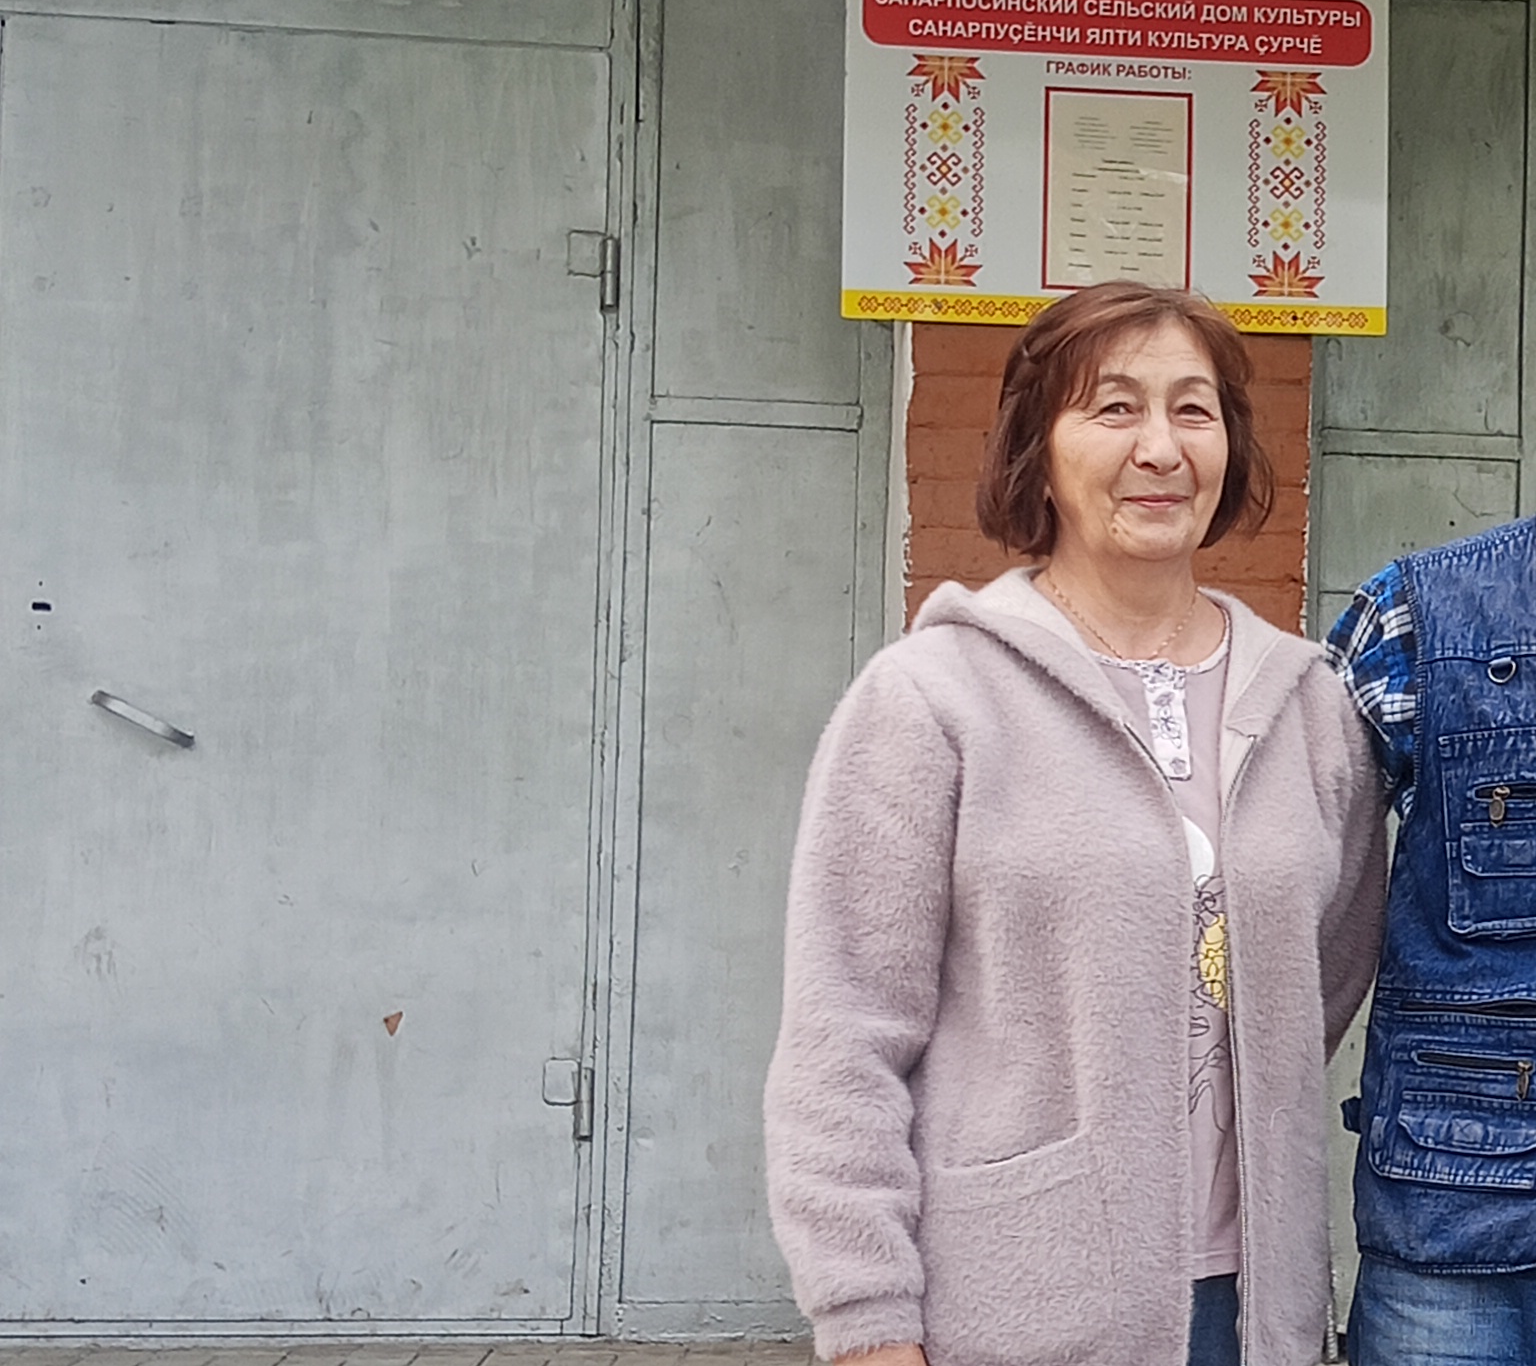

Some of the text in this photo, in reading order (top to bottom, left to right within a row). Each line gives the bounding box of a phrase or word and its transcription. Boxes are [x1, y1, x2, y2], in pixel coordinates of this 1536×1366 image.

[1200, 4, 1249, 24] ДОМ
[1253, 7, 1361, 28] КУЛЬТУРЫ
[1086, 26, 1142, 46] ЯЛТИ
[1146, 30, 1250, 52] КУЛЬТУРА
[1046, 60, 1193, 81] ГРАФИК РАБОТЫ:
